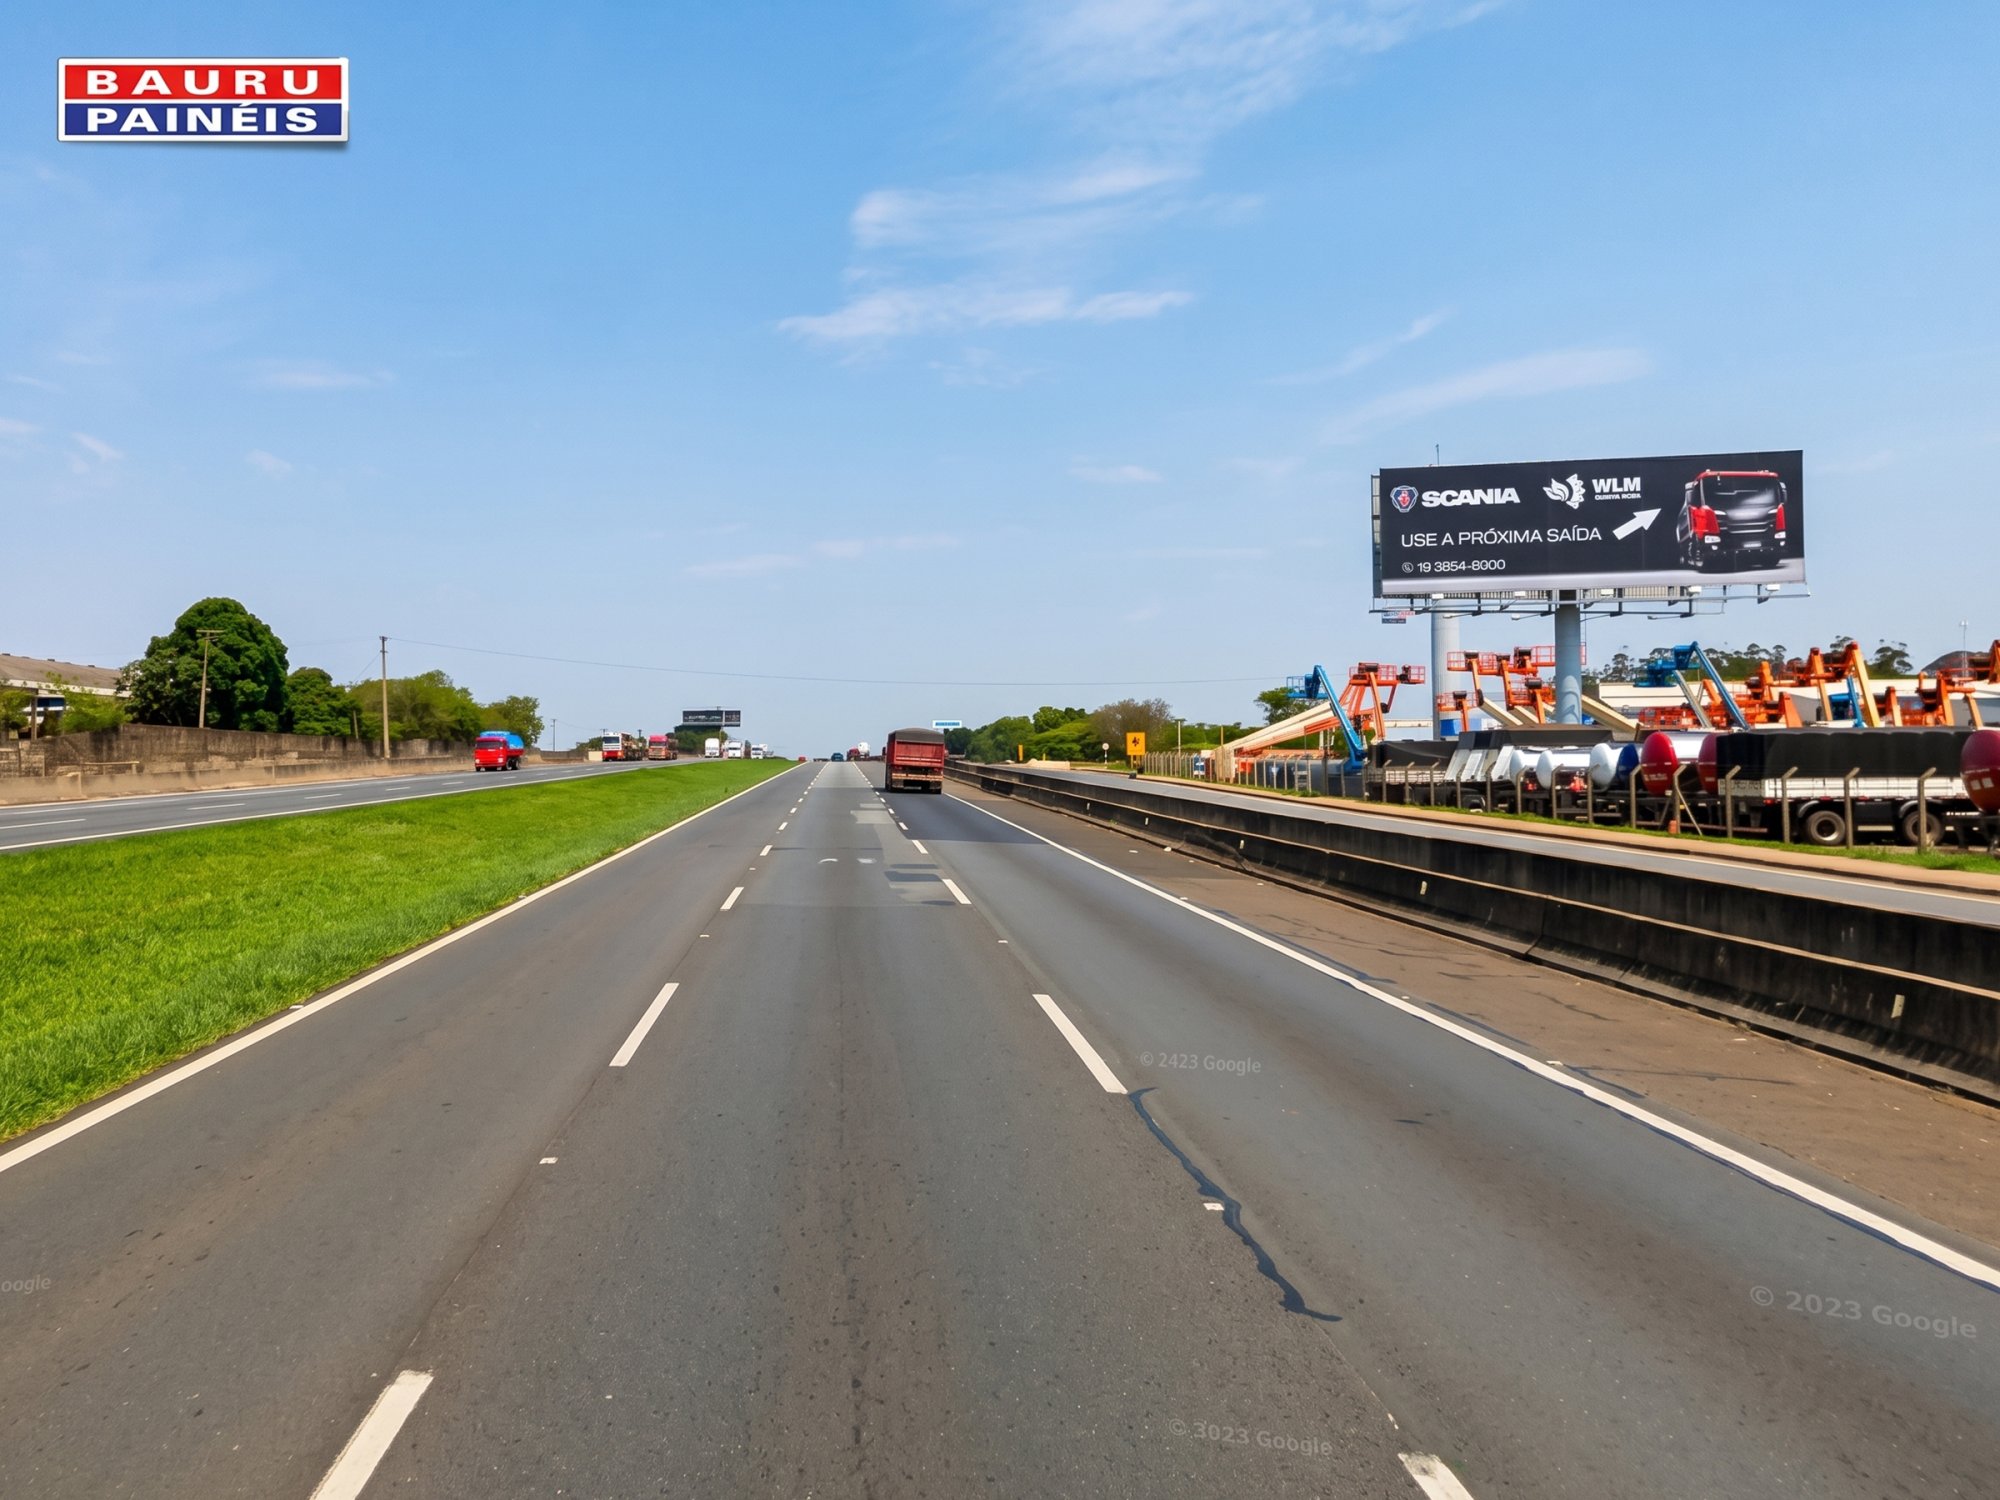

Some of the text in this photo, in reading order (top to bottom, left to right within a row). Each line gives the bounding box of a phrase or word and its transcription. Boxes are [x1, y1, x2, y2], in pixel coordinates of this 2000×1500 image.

[1592, 476, 1641, 493] WLM
[1421, 487, 1521, 508] SCANIA
[1401, 525, 1602, 547] USE A PRÓXIMA SAÍDA
[1417, 562, 1431, 573] 19
